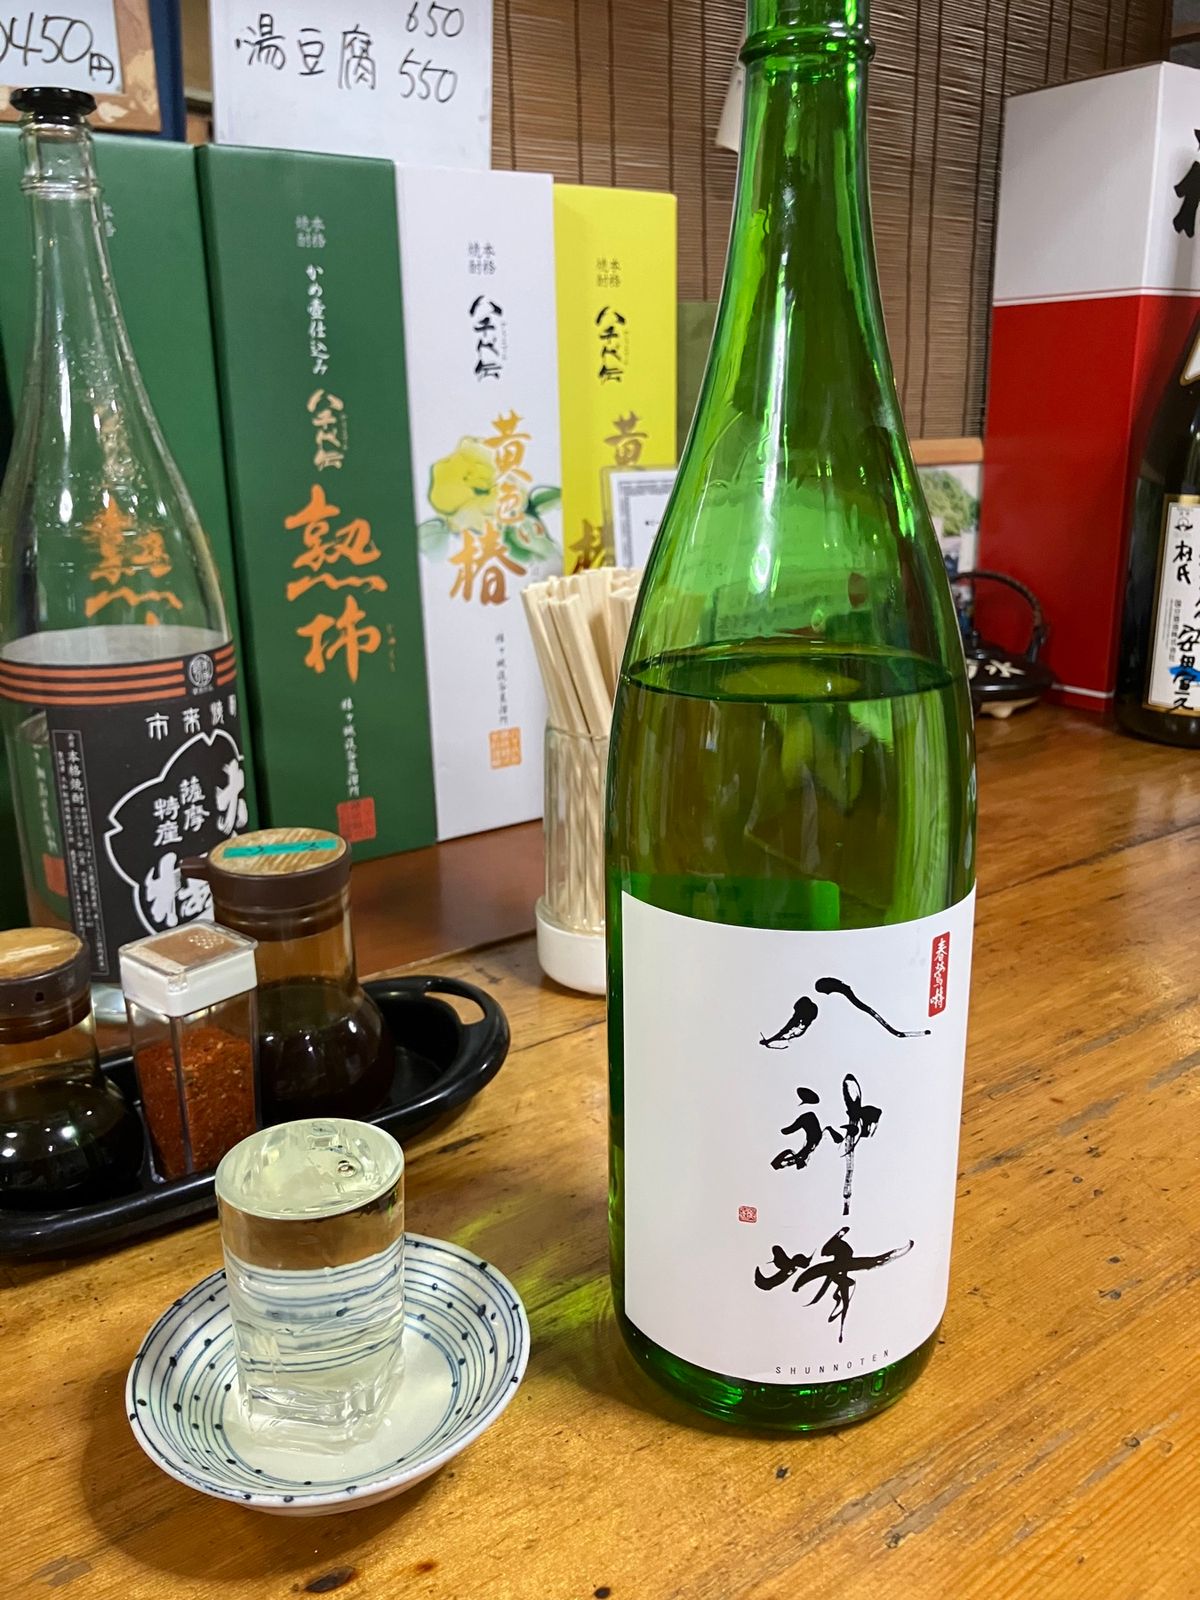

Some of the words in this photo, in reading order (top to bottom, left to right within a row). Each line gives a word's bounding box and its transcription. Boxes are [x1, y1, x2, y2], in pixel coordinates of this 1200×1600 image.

[406, 0, 464, 37] 650
[236, 14, 376, 90] 湯豆腐
[400, 48, 458, 102] 550
[285, 484, 388, 683] 熟柿
[153, 795, 183, 847] 特産
[775, 1349, 889, 1375] SHUNNOTEN
